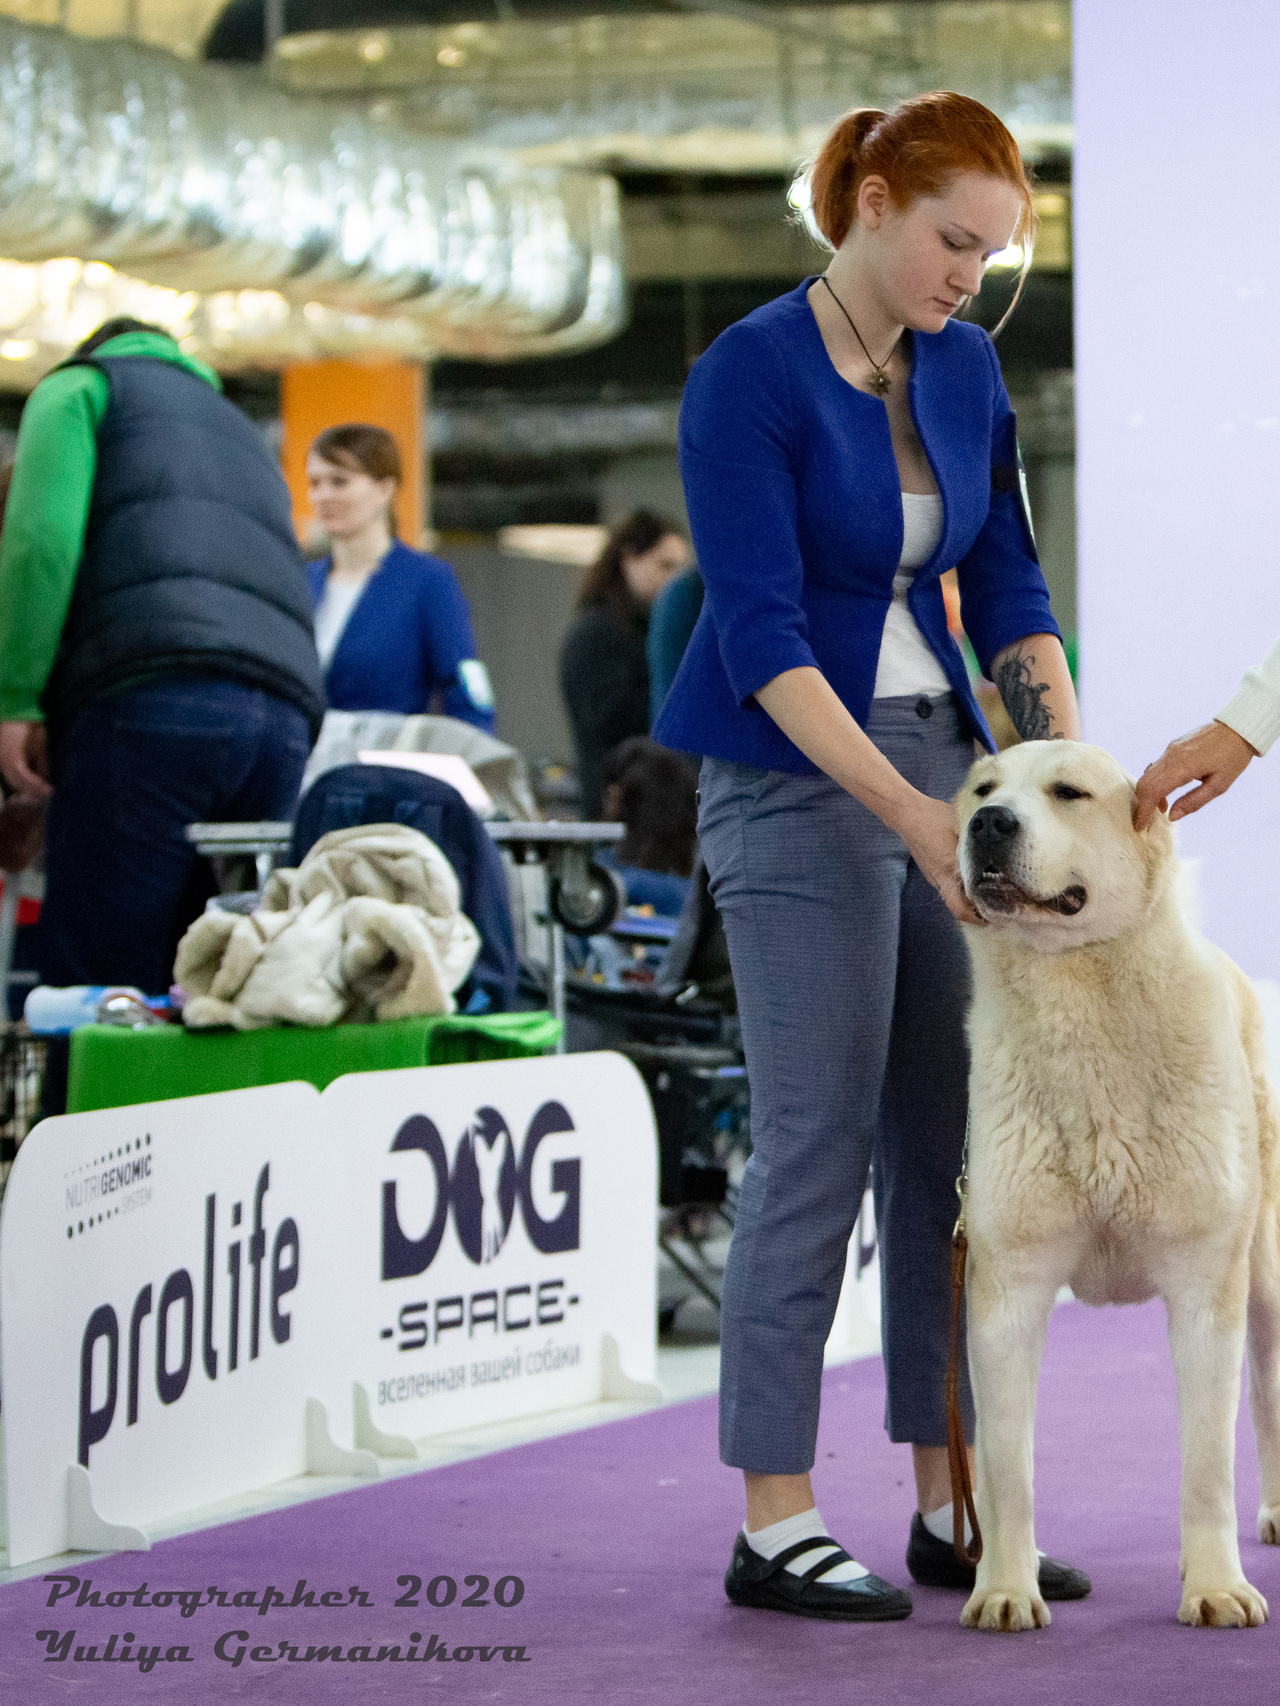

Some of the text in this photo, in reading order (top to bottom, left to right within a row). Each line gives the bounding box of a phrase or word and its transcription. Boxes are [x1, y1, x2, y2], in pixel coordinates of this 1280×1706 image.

[65, 1153, 152, 1212] NUTRIGENOMIC
[380, 1100, 583, 1281] DOG
[77, 1160, 300, 1469] prolife
[377, 1338, 581, 1405] вселенная вашей собаки
